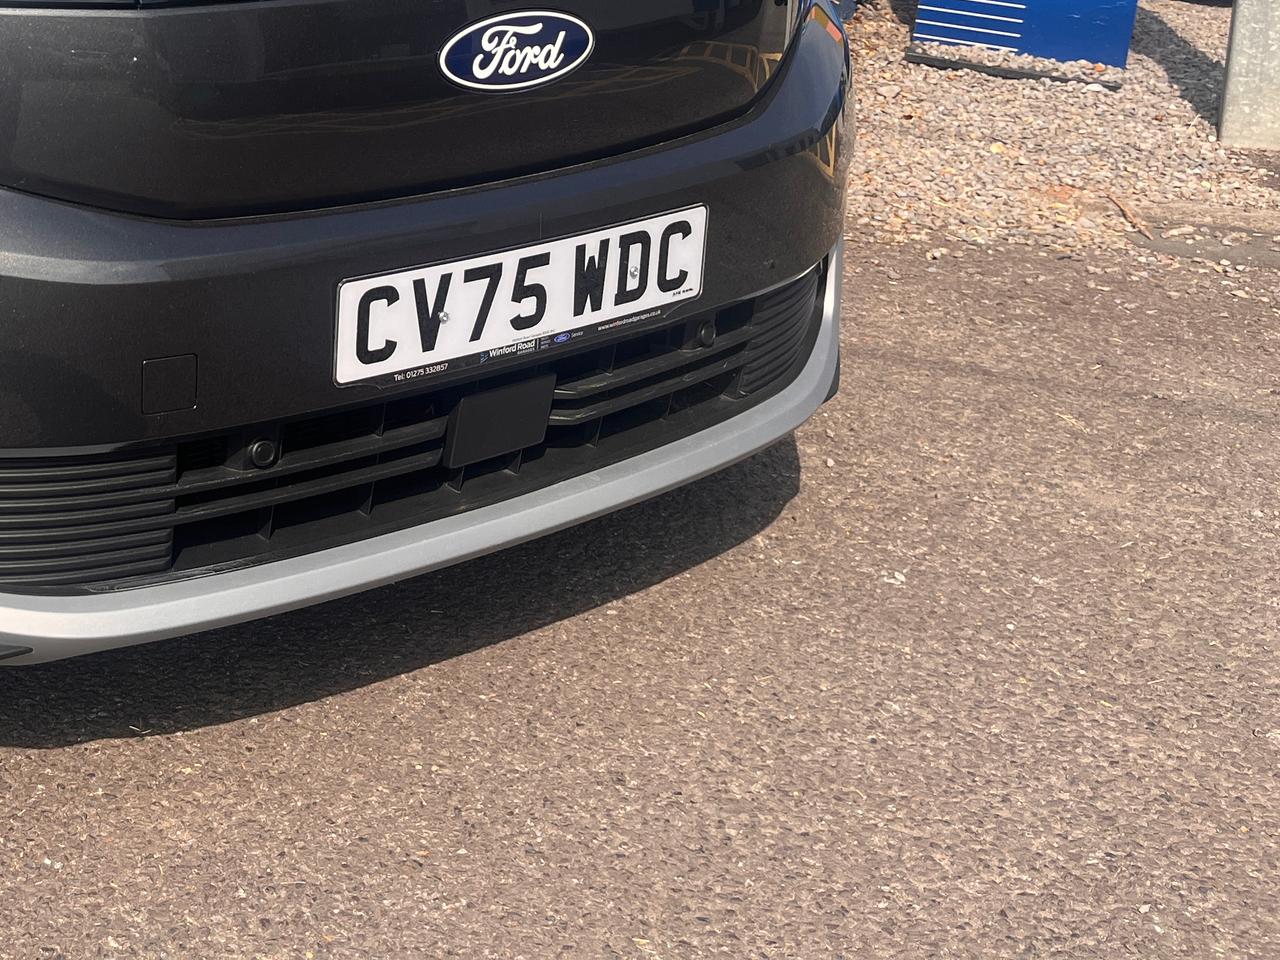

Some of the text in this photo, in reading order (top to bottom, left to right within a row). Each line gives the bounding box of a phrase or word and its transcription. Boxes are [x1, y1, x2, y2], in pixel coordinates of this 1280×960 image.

[472, 21, 564, 80] Ford
[355, 220, 692, 366] CV75 WDC
[489, 344, 518, 358] Winford
[517, 339, 536, 351] Road
[393, 362, 449, 382] Tel: 01275 332857
